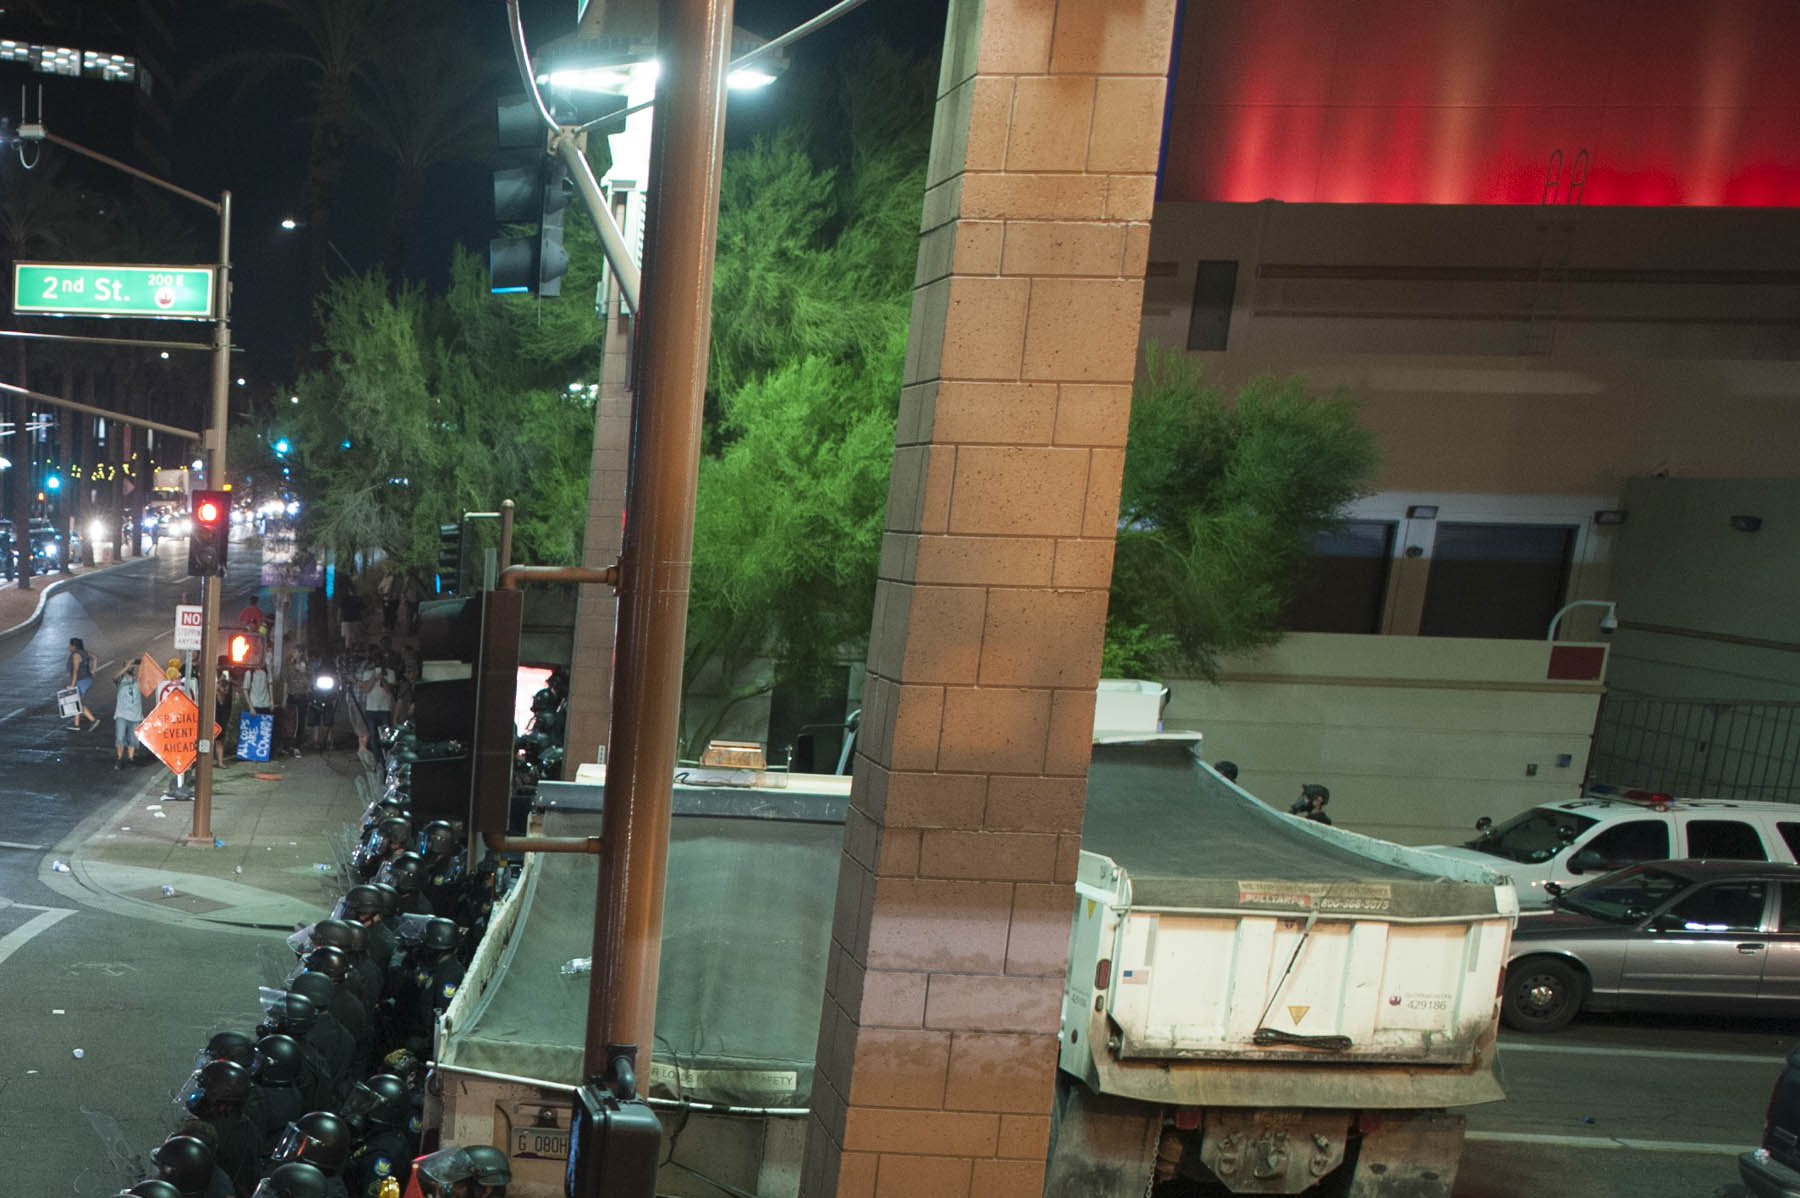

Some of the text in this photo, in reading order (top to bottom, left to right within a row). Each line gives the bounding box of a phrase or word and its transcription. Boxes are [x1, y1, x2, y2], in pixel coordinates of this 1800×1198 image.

[148, 274, 173, 287] 200
[42, 276, 131, 302] 2nd St.
[183, 612, 201, 625] NO
[163, 727, 193, 739] EVENT
[163, 743, 196, 753] AHEAD
